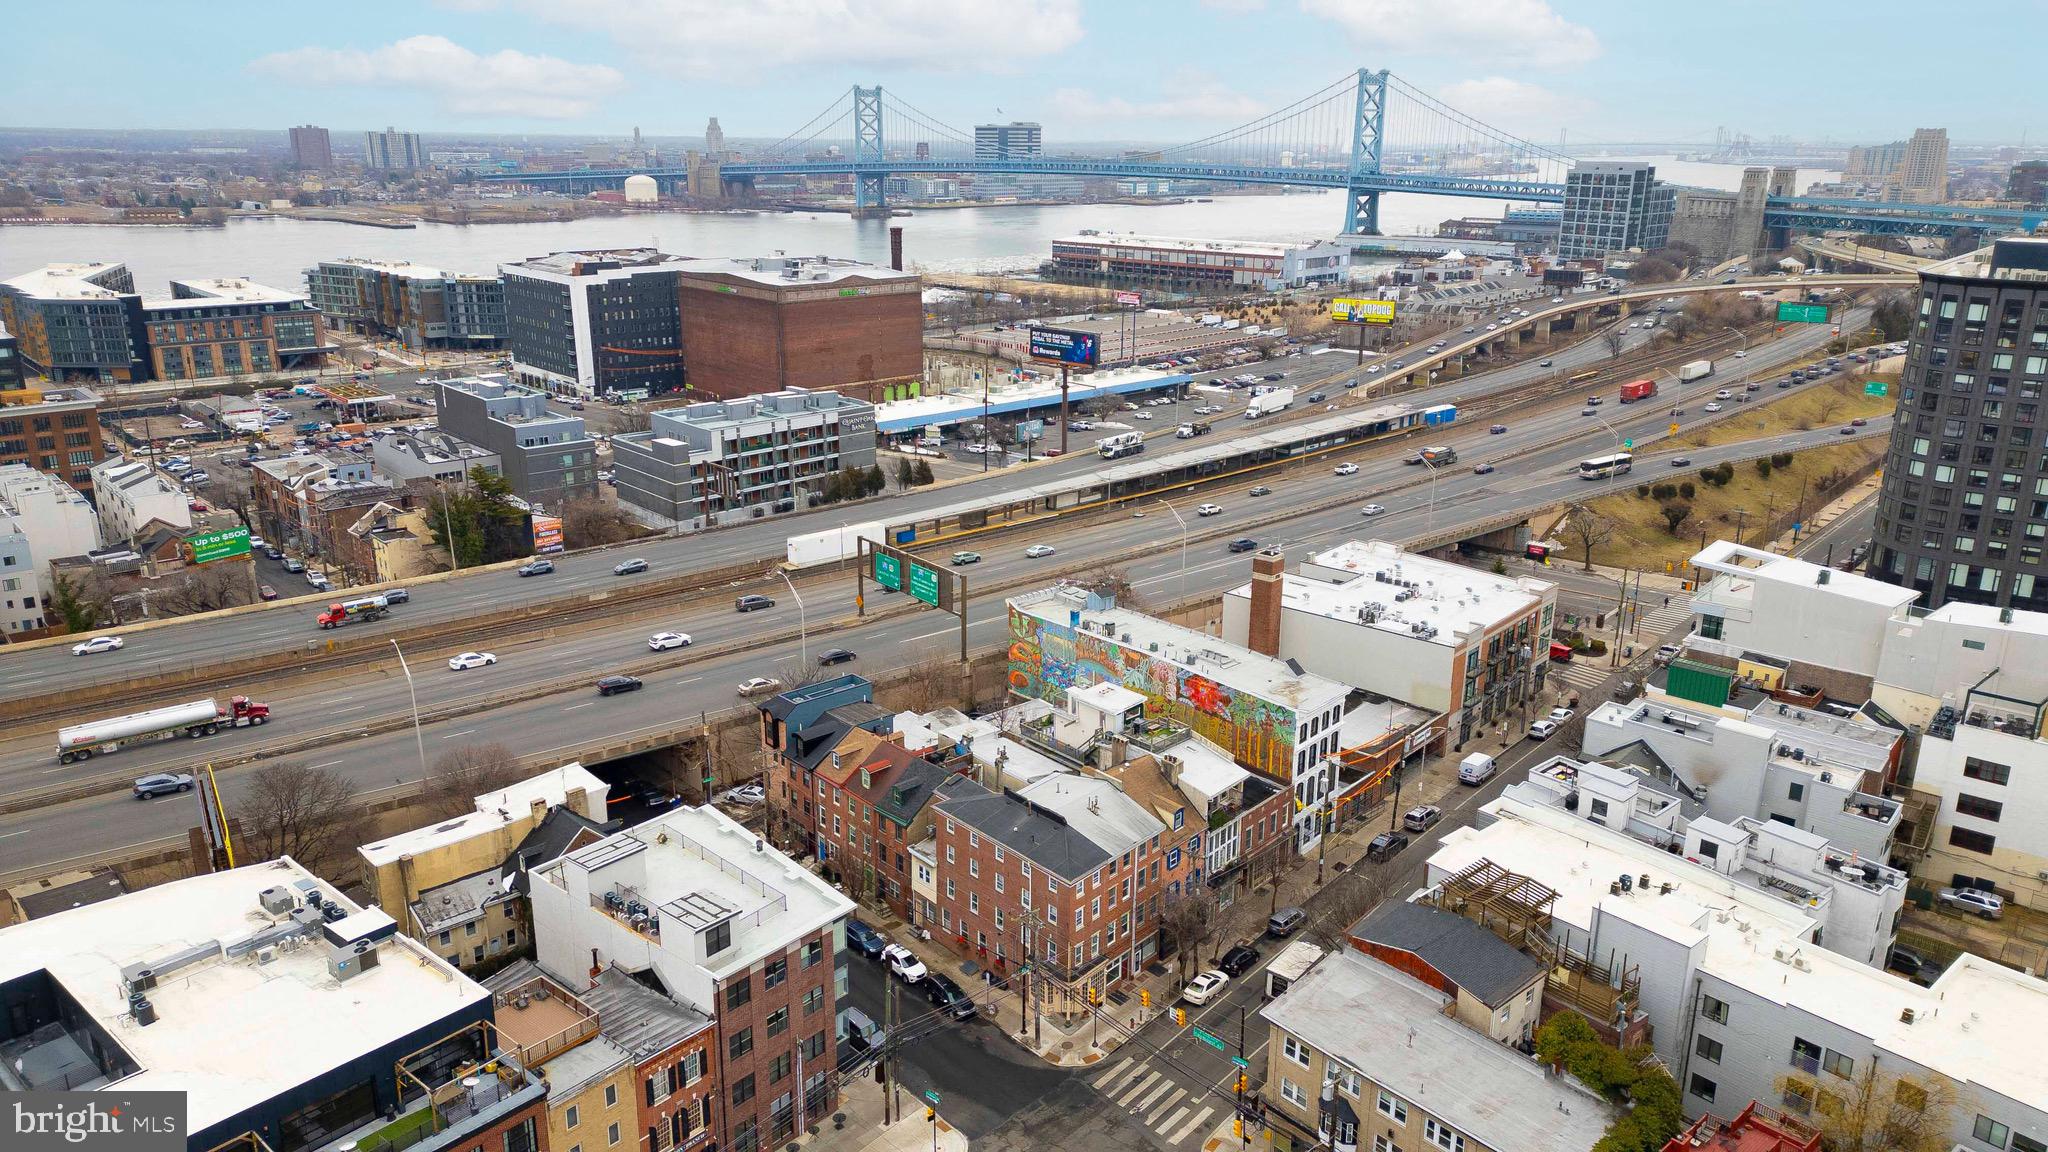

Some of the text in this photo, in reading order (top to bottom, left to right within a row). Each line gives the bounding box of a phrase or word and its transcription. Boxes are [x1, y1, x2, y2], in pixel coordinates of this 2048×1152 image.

[1039, 347, 1061, 356] Rewards
[851, 423, 866, 431] BANK
[195, 538, 209, 546] Up
[222, 529, 248, 540] $500
